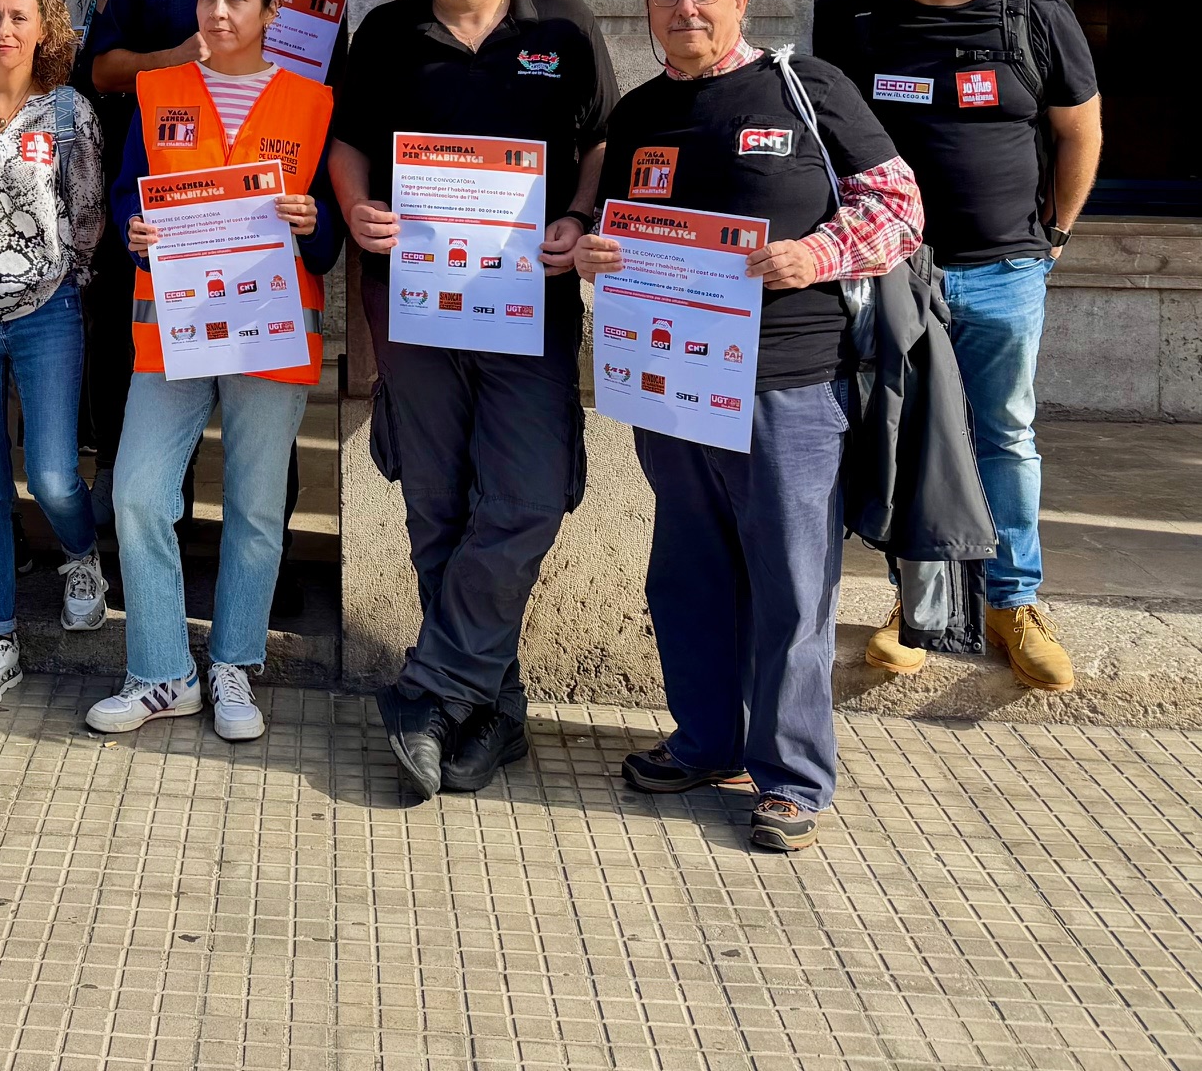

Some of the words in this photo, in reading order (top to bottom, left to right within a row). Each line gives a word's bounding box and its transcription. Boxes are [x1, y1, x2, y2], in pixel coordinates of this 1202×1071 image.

[878, 80, 914, 91] CCOO
[963, 82, 973, 94] JO
[973, 81, 991, 93] VAIG
[260, 137, 300, 157] SINDICAT
[402, 143, 431, 151] VAGA
[433, 144, 475, 153] GENERAL
[747, 134, 784, 148] CNT
[421, 152, 483, 163] L'HABITATGE
[504, 148, 537, 168] 11N
[147, 185, 174, 194] VAGA
[175, 179, 215, 190] GENERAL
[242, 172, 275, 191] 11N
[148, 194, 164, 202] PER
[166, 187, 224, 200] L'HABITATGE
[612, 210, 642, 222] VAGA
[643, 215, 688, 229] GENERAL
[610, 220, 628, 229] PER
[630, 223, 696, 240] L'HABITATGE
[719, 225, 758, 248] 11N
[652, 339, 669, 350] CGT
[687, 343, 705, 353] CNT
[711, 395, 728, 404] UGT
